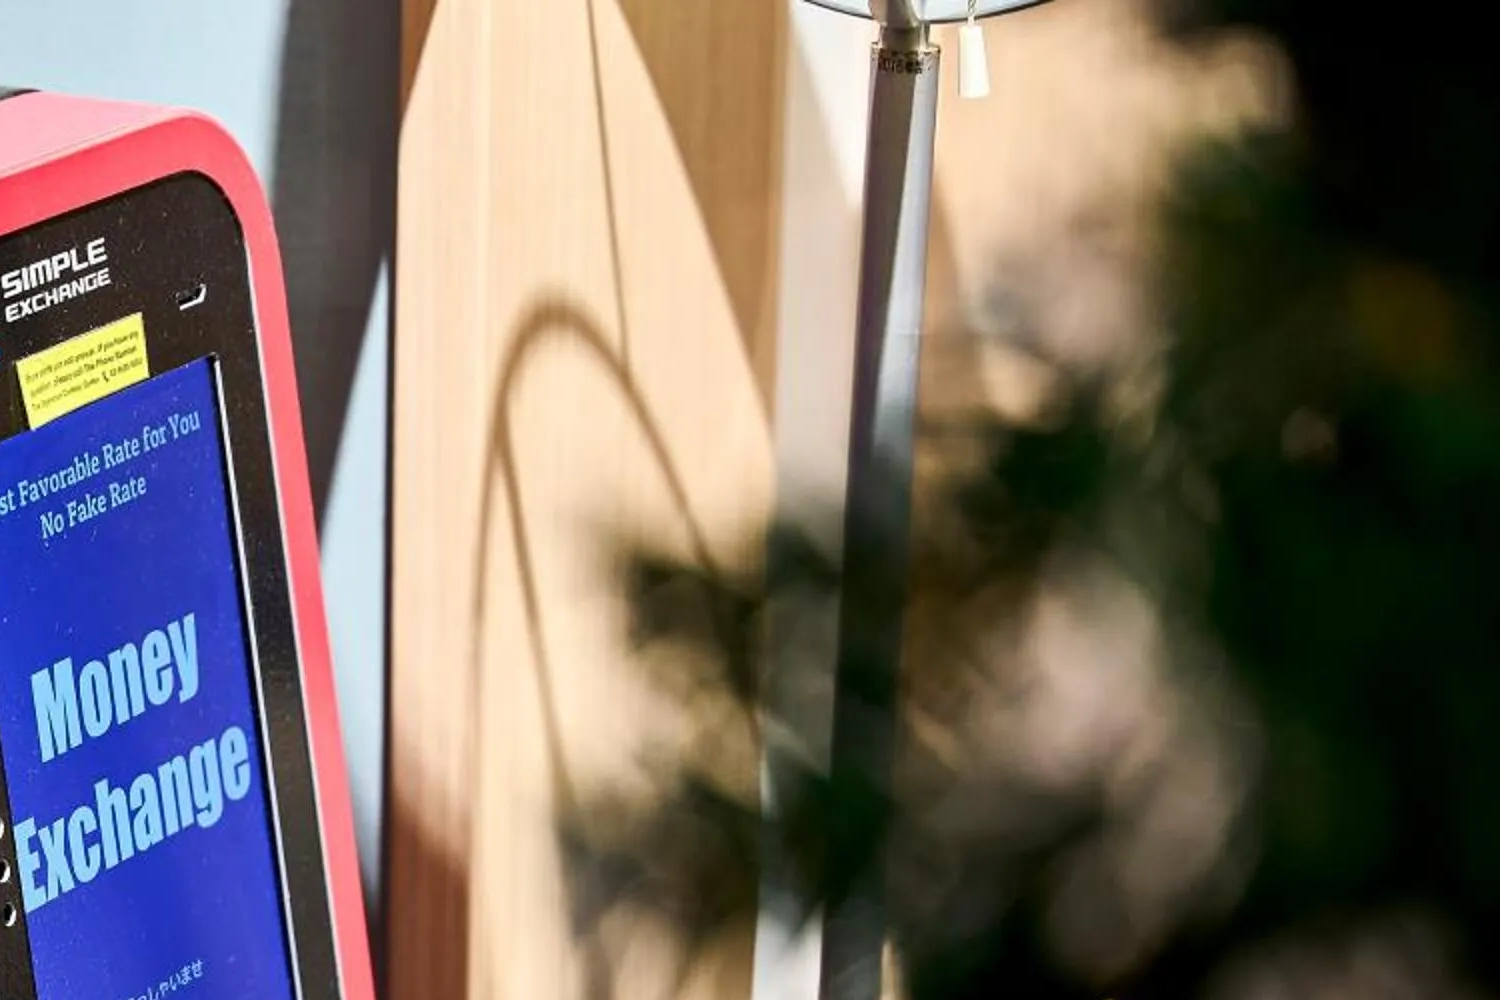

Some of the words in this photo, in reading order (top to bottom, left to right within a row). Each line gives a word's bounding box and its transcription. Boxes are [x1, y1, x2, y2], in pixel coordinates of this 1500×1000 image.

[1, 237, 108, 299] SIMPLE
[5, 267, 111, 323] EXCHANGE
[18, 452, 100, 507] Favorable
[102, 436, 140, 469] Rate
[142, 425, 166, 451] for
[168, 411, 200, 439] You
[40, 512, 64, 539] No
[67, 493, 107, 527] Fake
[109, 476, 147, 508] Rate
[31, 612, 199, 763] Money
[13, 725, 251, 914] Exchange
